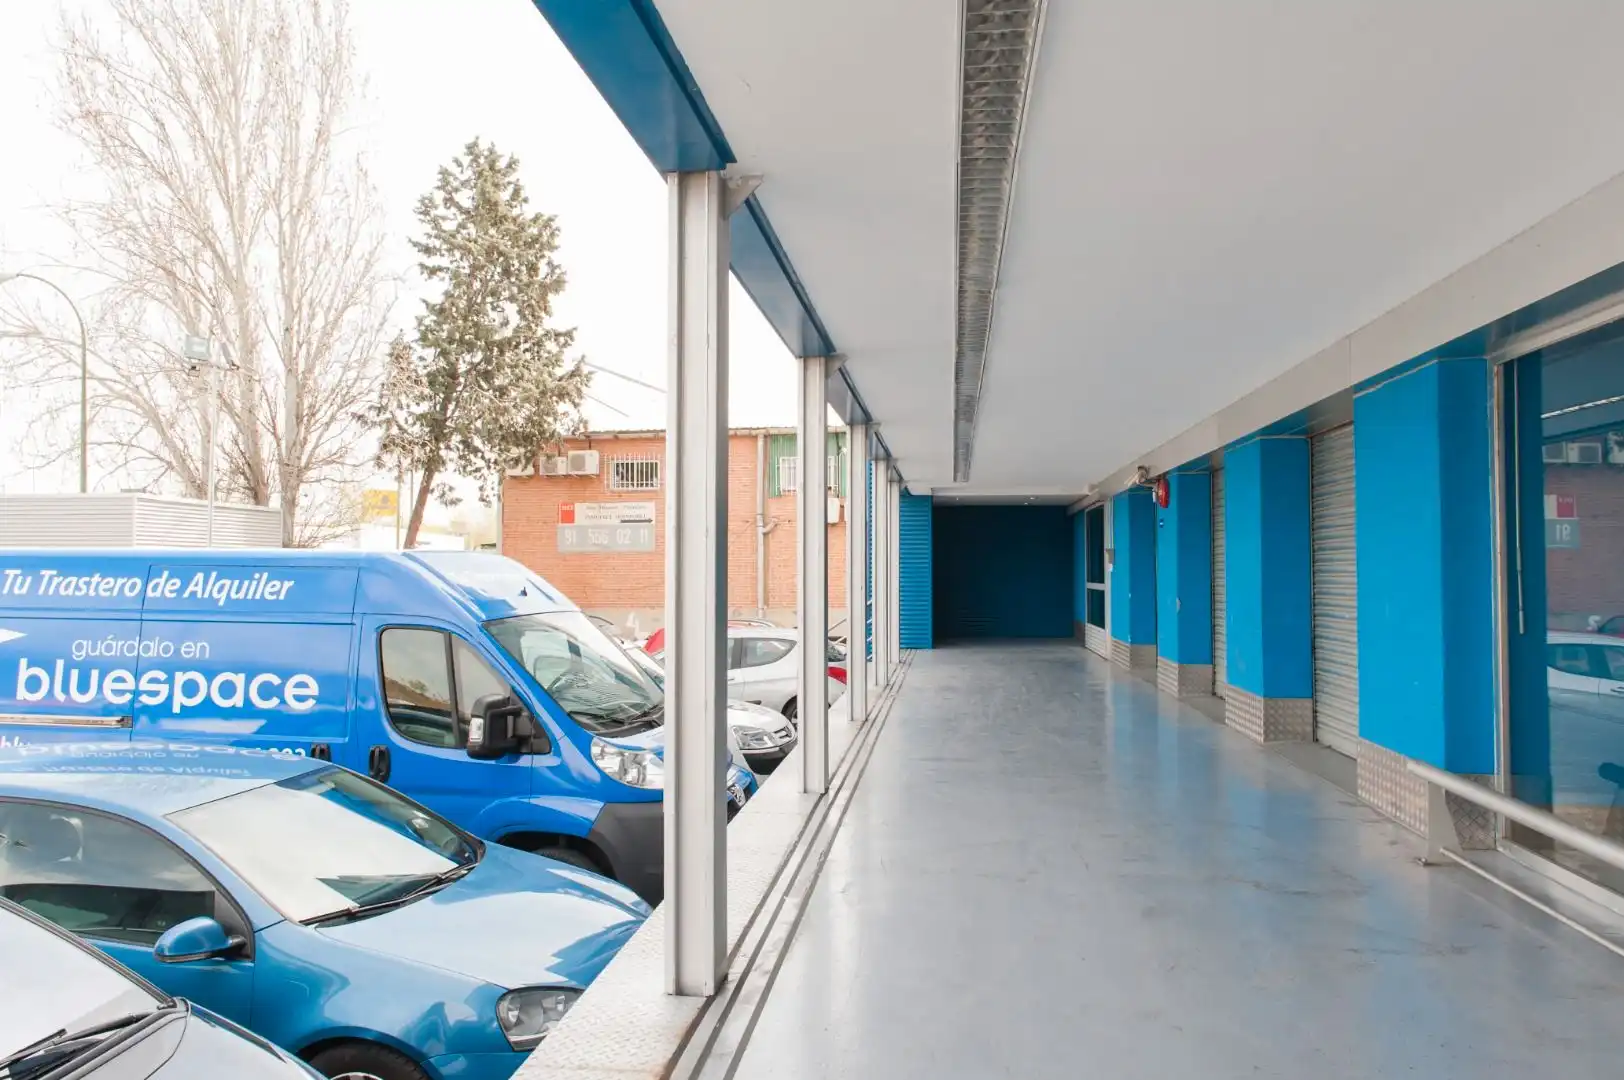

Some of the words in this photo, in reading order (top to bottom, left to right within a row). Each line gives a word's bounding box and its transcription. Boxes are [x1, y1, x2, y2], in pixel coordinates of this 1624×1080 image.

[564, 528, 577, 545] 91
[616, 528, 632, 545] 02
[2, 569, 31, 595] Tu
[37, 569, 142, 597] Trastero
[146, 570, 179, 598] de
[183, 572, 295, 606] Alquiler
[72, 634, 174, 661] guárdalo
[180, 639, 210, 659] en
[15, 657, 320, 714] bluespace
